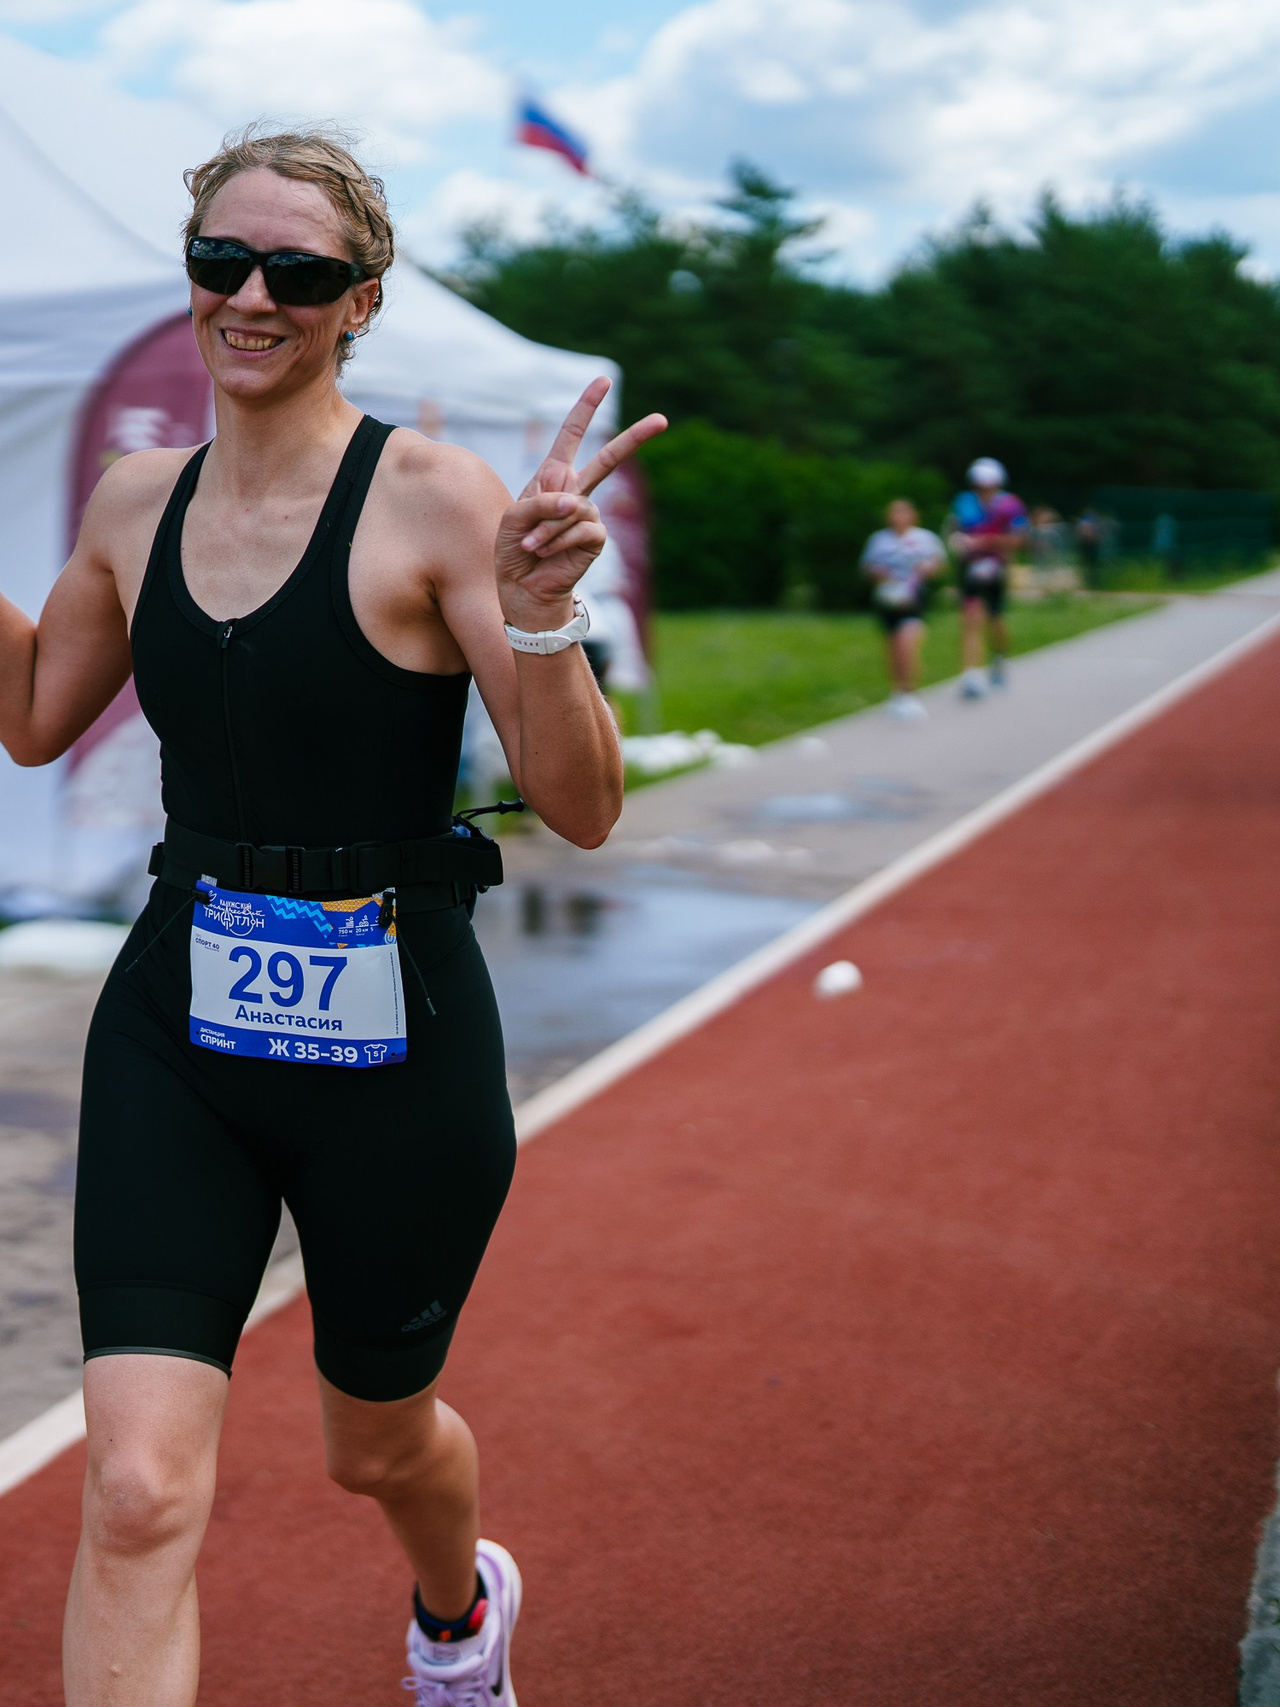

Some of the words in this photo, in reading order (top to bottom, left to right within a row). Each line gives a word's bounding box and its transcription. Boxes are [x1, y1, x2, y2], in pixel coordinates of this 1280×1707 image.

[228, 945, 348, 1012] 297
[234, 1004, 343, 1032] Анастасия
[200, 1027, 226, 1038] ДИСТАНЦИЯ
[200, 1033, 236, 1050] СПРИНТ
[268, 1038, 290, 1057] Ж
